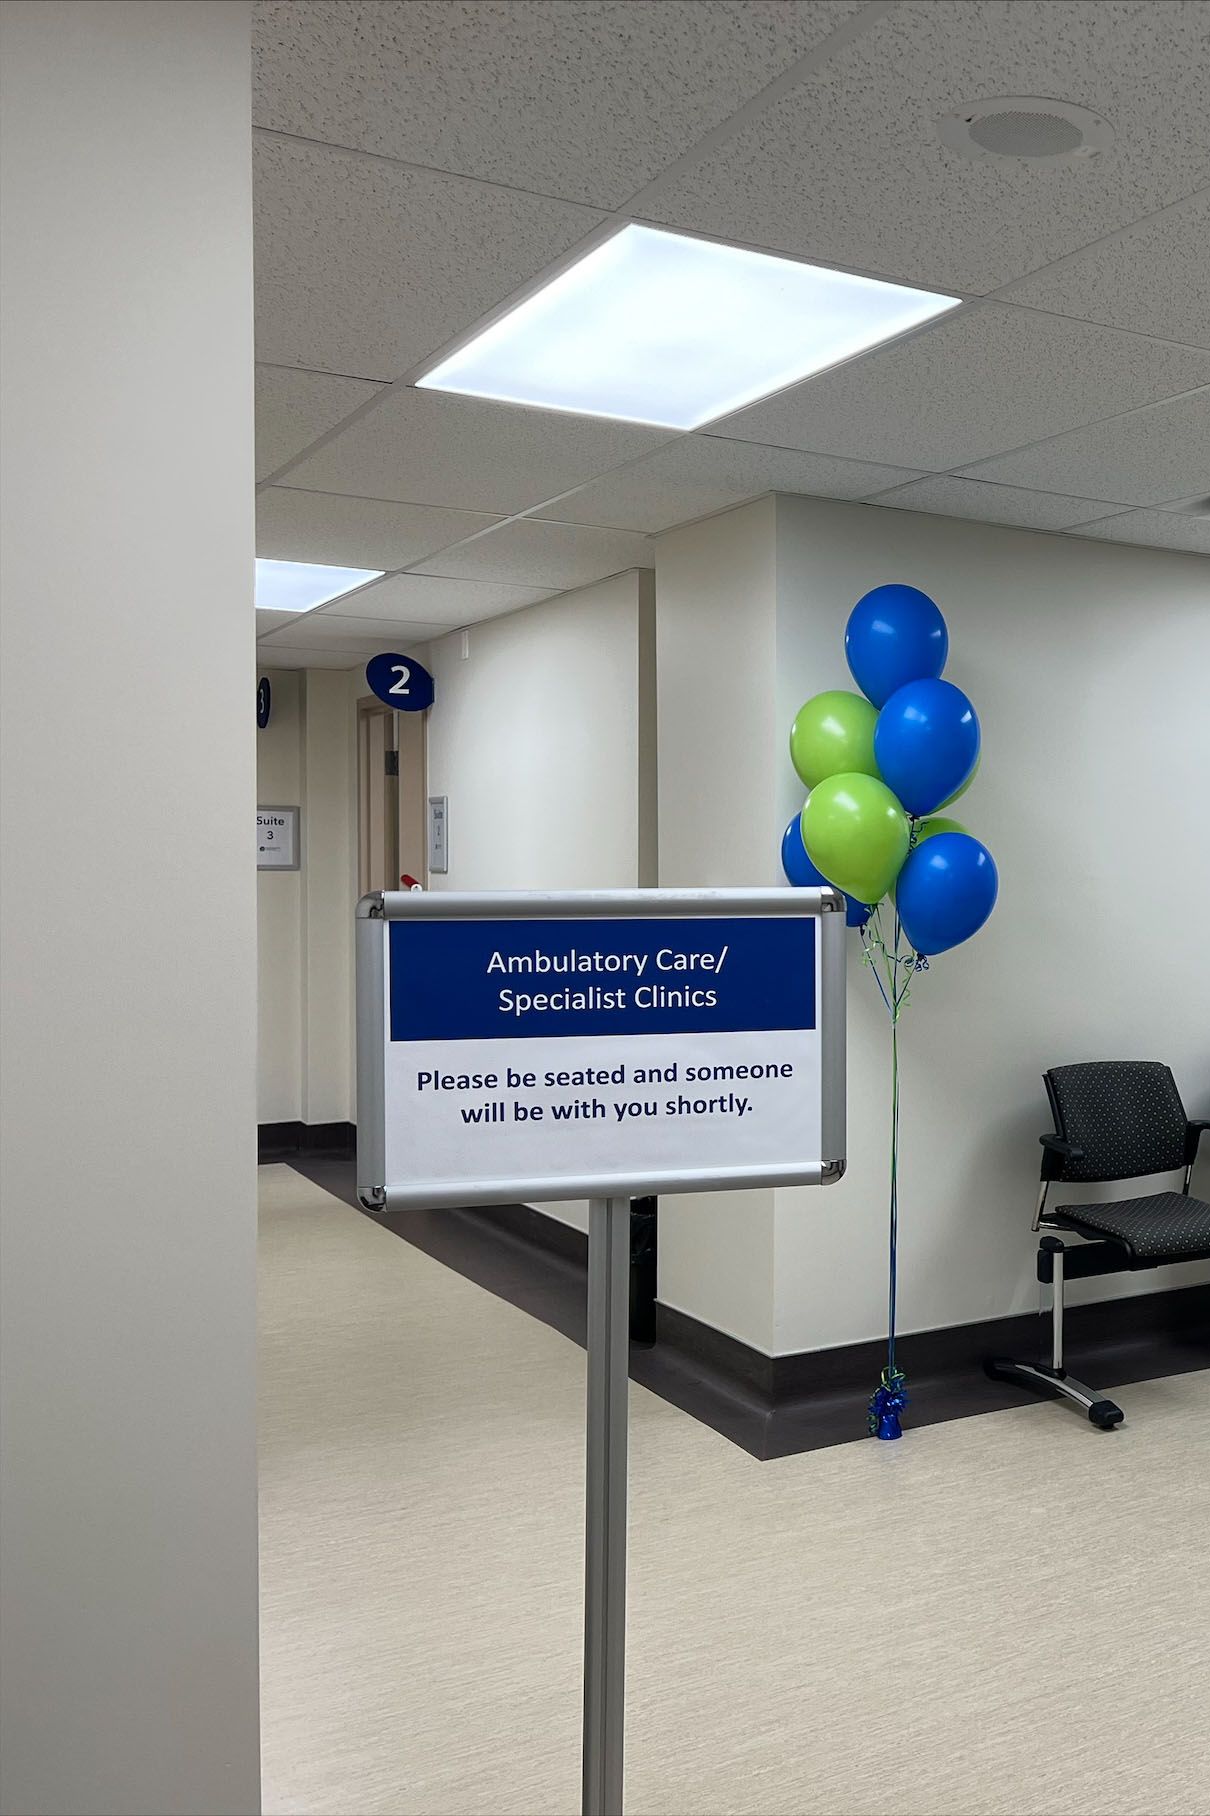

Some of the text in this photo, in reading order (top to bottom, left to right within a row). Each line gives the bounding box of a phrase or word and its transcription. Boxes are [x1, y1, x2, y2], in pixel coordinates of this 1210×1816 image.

[388, 665, 410, 695] 2
[256, 815, 285, 826] Suite
[266, 830, 274, 840] 3
[486, 945, 729, 977] Ambulatory Care/
[498, 984, 718, 1017] Specialist Clinics
[417, 1062, 793, 1091] Please be seated and someone
[461, 1092, 753, 1124] will be with you shortly.
